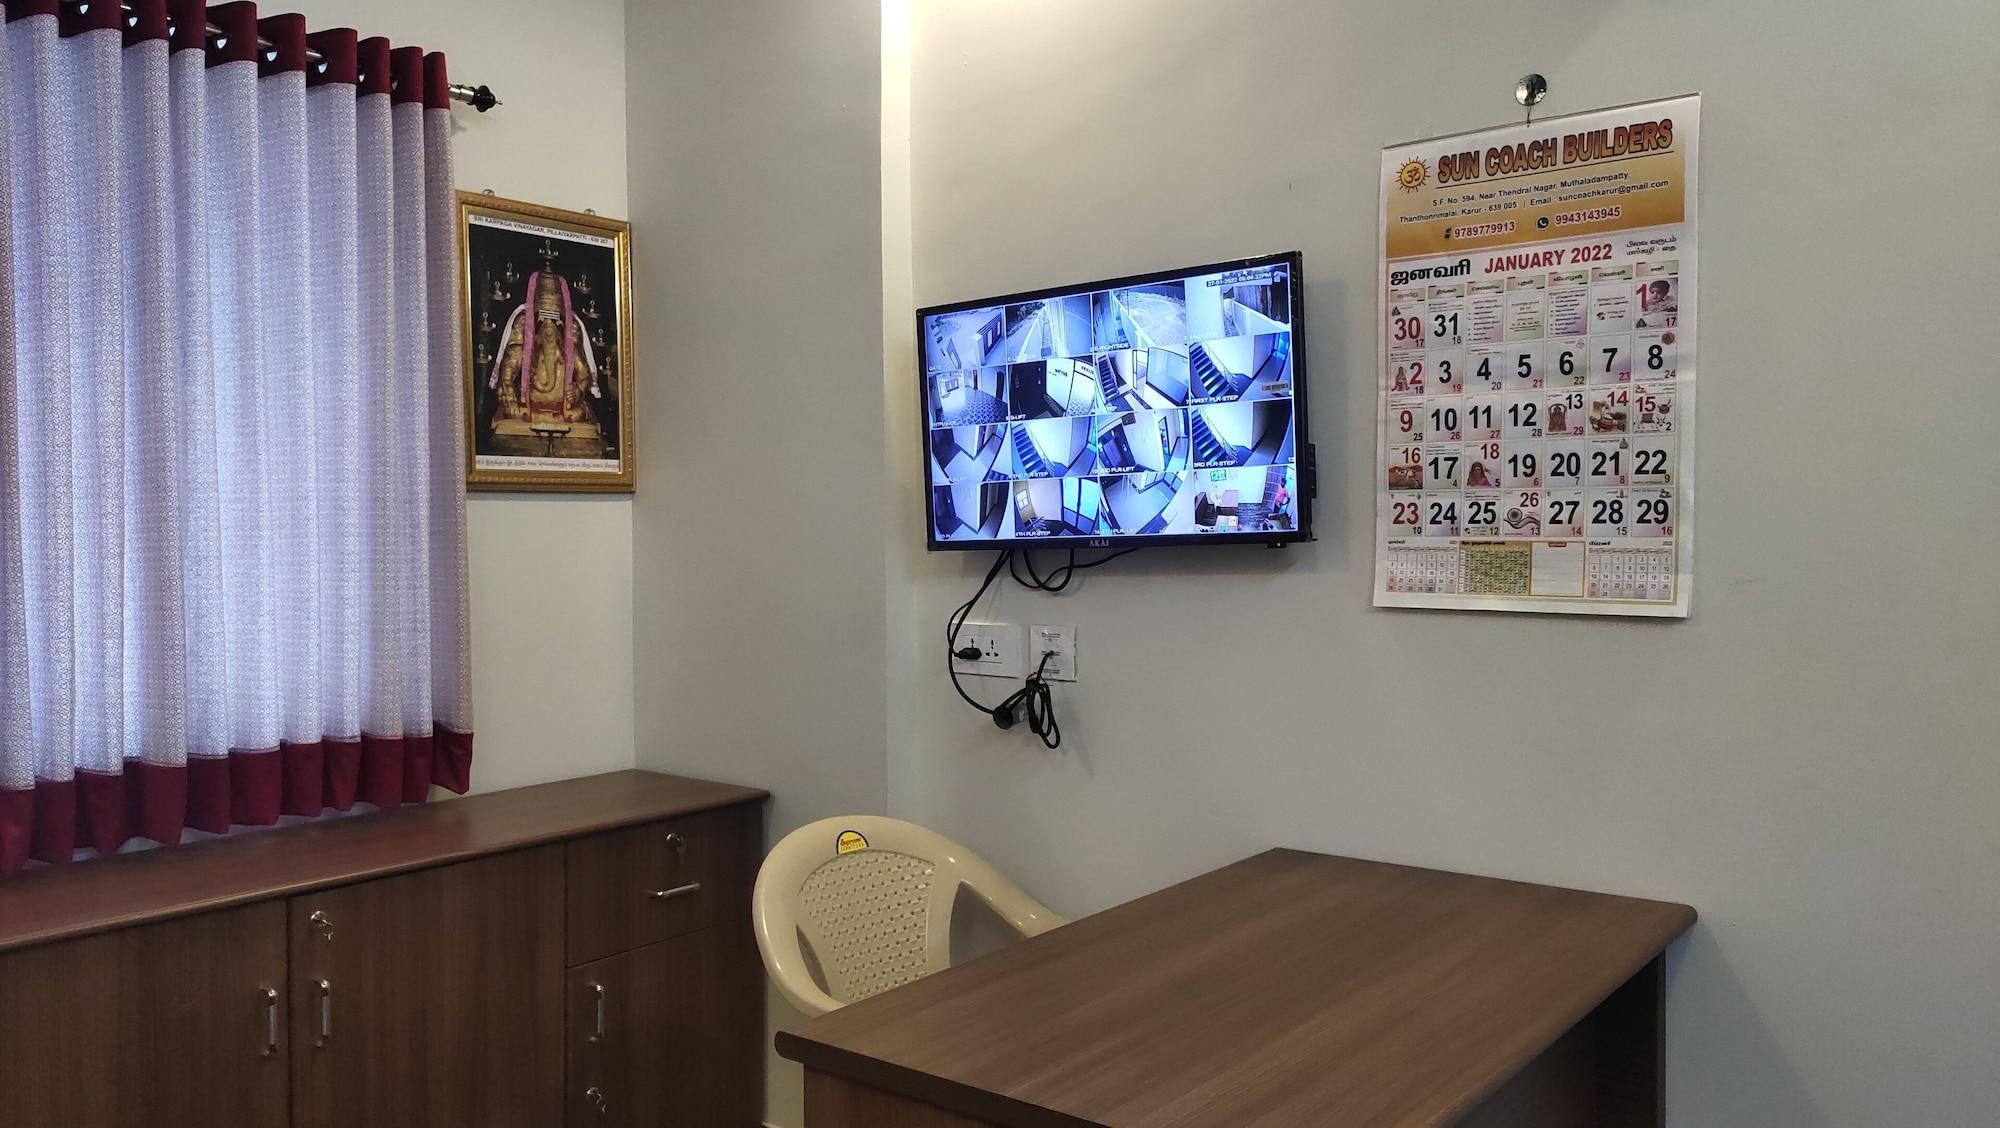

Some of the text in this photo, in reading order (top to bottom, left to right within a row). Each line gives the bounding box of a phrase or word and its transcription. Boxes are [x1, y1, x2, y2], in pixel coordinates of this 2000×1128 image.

[1438, 119, 1673, 183] SUN COACH BUILDERS
[1499, 186, 1531, 197] Thendral
[1462, 207, 1481, 215] Karur
[1556, 207, 1620, 225] 9943143945
[1455, 221, 1515, 238] 9789779913
[1391, 258, 1470, 286] ஜனவரி
[1485, 244, 1612, 274] JANUARY 2022
[1395, 317, 1420, 341] 30
[1434, 313, 1458, 337] 31
[1636, 284, 1647, 310] 1
[1416, 317, 1676, 347] 17 18 17
[1410, 345, 1663, 385] 2 3 4 5 6 7 8
[1415, 370, 1676, 394] 18 19 20 21 22 23 24
[1400, 391, 1656, 433] 9 10 11 12 13 14 15
[1414, 433, 1423, 441] 25
[1451, 432, 1461, 440] 26
[1490, 430, 1500, 439] 27
[1532, 429, 1542, 437] 28
[1573, 426, 1584, 435] 29
[1666, 423, 1671, 431] 2
[1402, 443, 1667, 480] 16 17 18 19 20 21 22
[1452, 479, 1457, 487] 4
[1495, 479, 1500, 487] 5
[1533, 478, 1539, 486] 6
[1575, 477, 1580, 485] 7
[1619, 475, 1625, 484] 8
[1665, 474, 1670, 483] 9
[1393, 493, 1669, 524] 23 24 25 26 27 28 29
[1089, 539, 1109, 547] AKAI
[1413, 527, 1673, 536] 10 11 12 13 14 15 16
